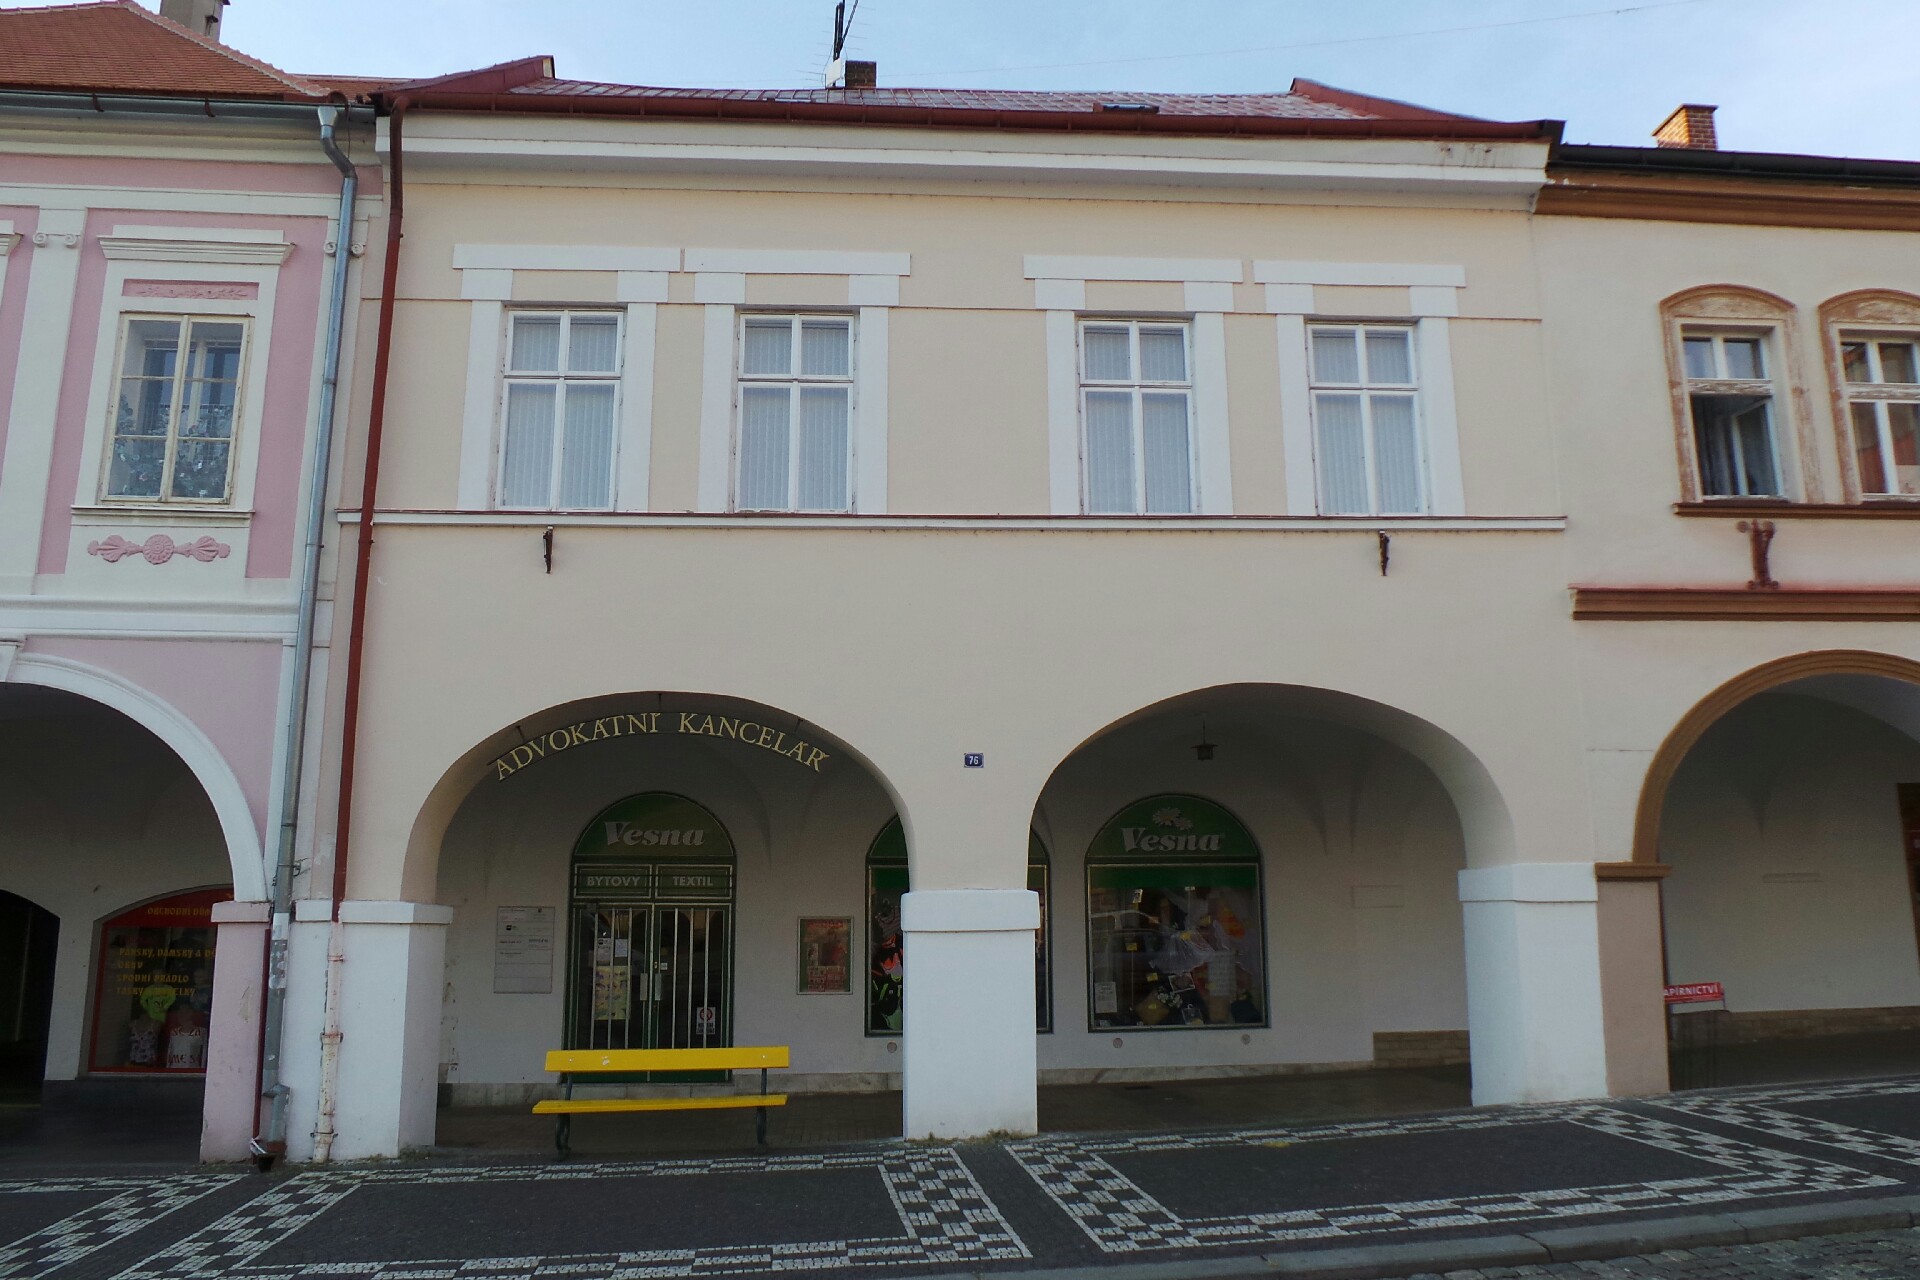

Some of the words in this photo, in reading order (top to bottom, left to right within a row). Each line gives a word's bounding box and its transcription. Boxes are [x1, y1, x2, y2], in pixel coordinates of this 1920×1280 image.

[496, 712, 661, 782] ADVOKÁTNÍ
[678, 711, 830, 773] KANCELÁŘ
[969, 755, 979, 765] 76
[605, 821, 706, 846] Vesna
[1121, 826, 1223, 852] Vesna
[672, 876, 714, 887] TEXTIL
